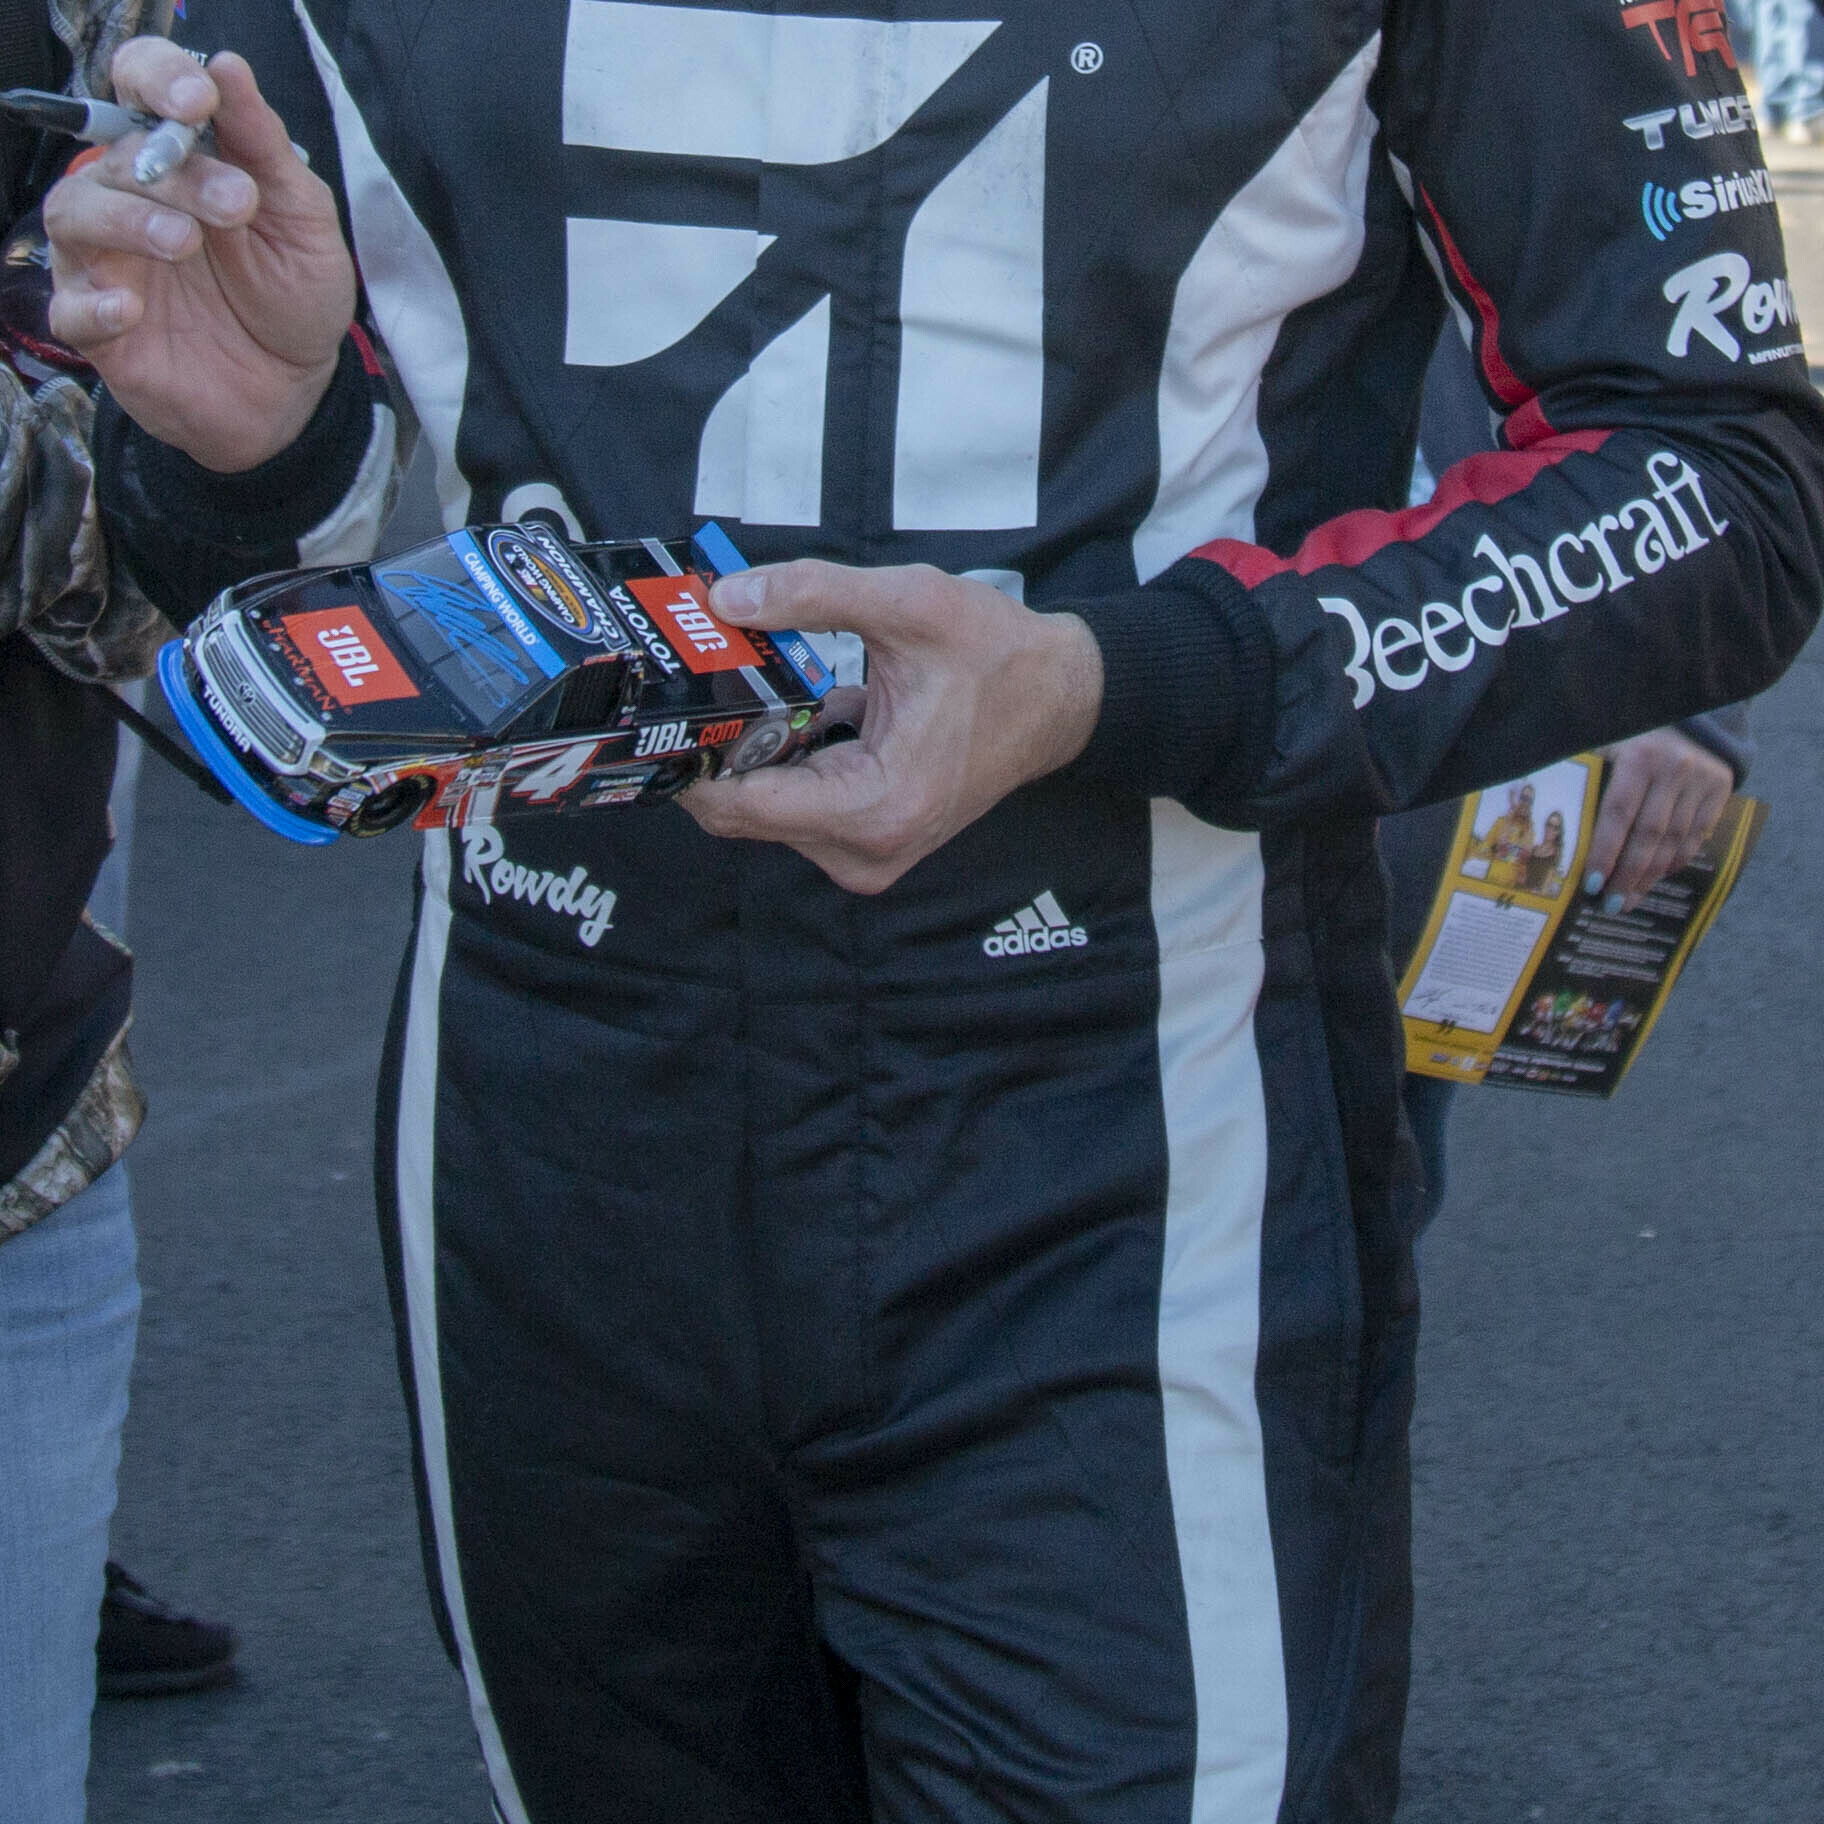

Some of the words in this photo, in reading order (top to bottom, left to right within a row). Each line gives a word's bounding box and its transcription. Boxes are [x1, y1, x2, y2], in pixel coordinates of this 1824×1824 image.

[463, 552, 503, 605] CAMPING
[497, 601, 538, 646] WORLD
[536, 535, 620, 639] CHAMPION
[1318, 450, 1732, 712] Beechcraft
[316, 624, 380, 688] JBL
[609, 584, 681, 674] TOYOTA
[666, 591, 728, 654] JBL
[200, 685, 252, 754] TUNDRA
[634, 719, 745, 758] JBL.com
[510, 740, 603, 805] 4
[461, 823, 618, 948] Rowdy
[983, 922, 1090, 958] adidas
